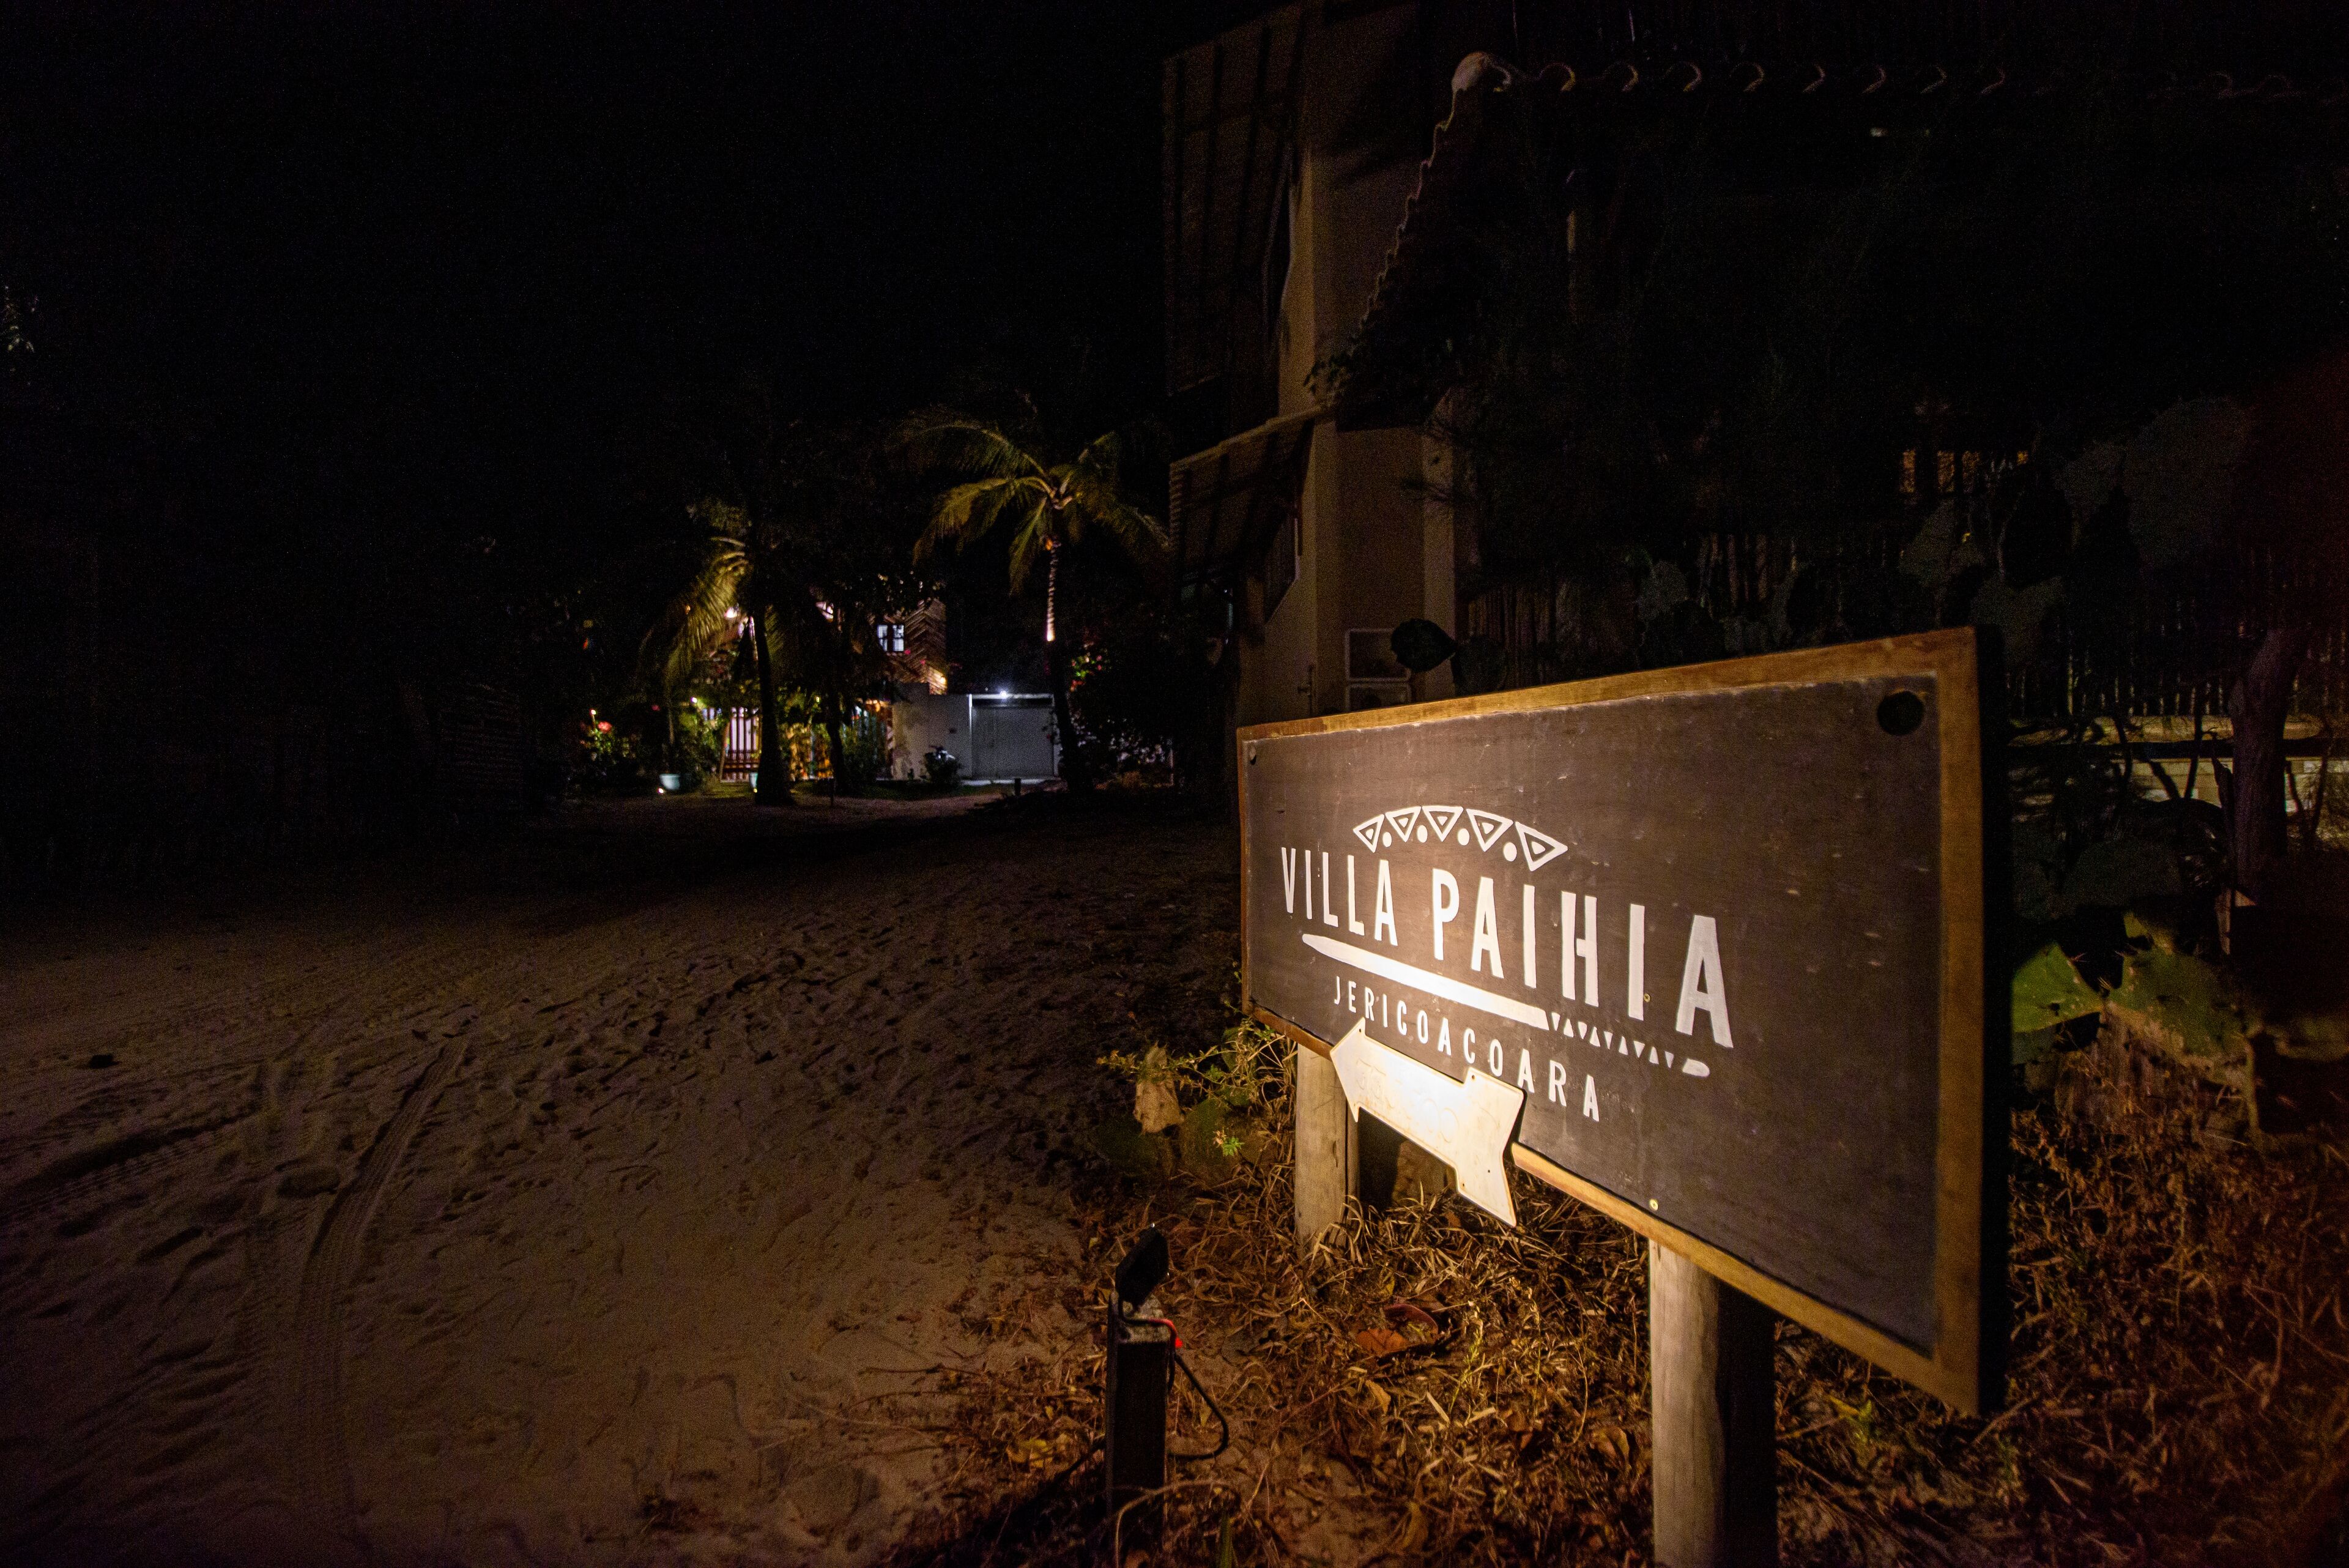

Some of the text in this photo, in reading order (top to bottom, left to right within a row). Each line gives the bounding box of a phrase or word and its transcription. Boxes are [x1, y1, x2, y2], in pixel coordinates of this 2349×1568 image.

[1281, 847, 1734, 1049] VILLA PAIHIA
[1334, 976, 1600, 1122] JERICOACOARA
